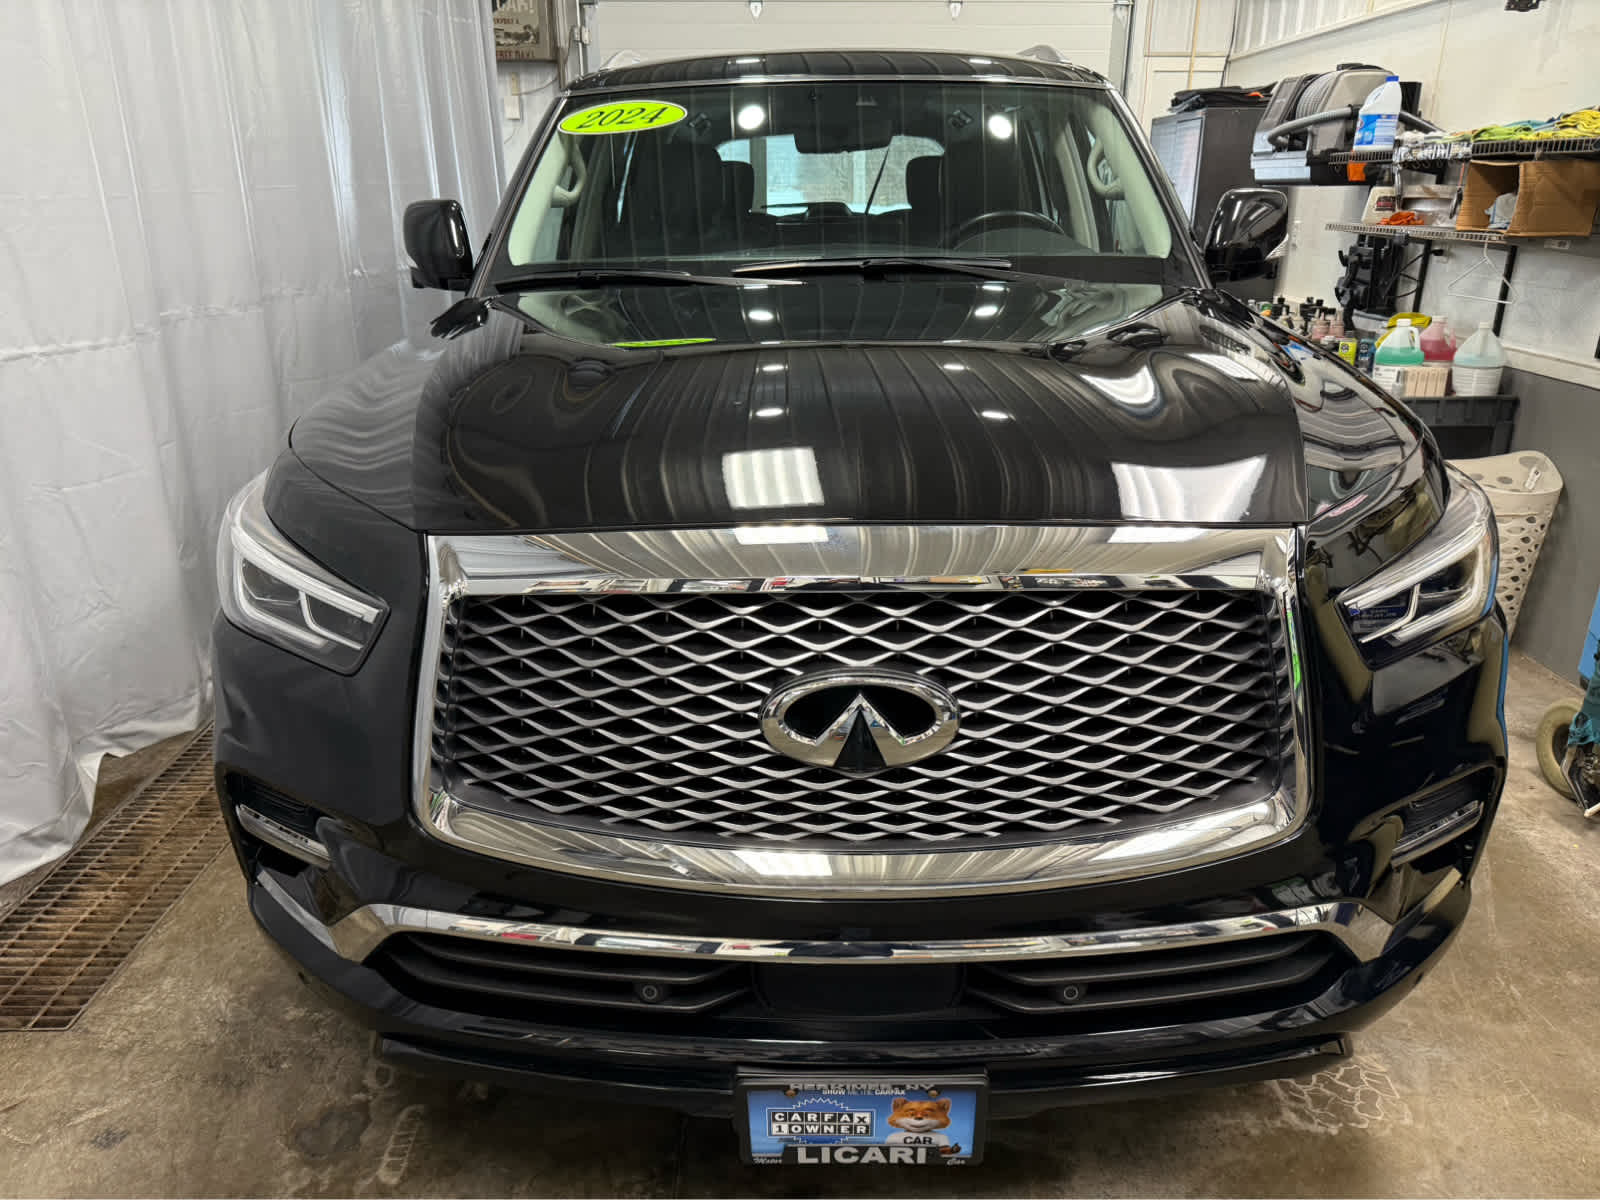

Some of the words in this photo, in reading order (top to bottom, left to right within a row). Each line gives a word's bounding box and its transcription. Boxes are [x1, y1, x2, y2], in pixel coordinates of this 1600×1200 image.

[576, 107, 668, 129] 2024
[774, 1112, 870, 1124] CARFAX
[903, 1135, 933, 1145] CAR
[797, 1146, 927, 1164] LICARI
